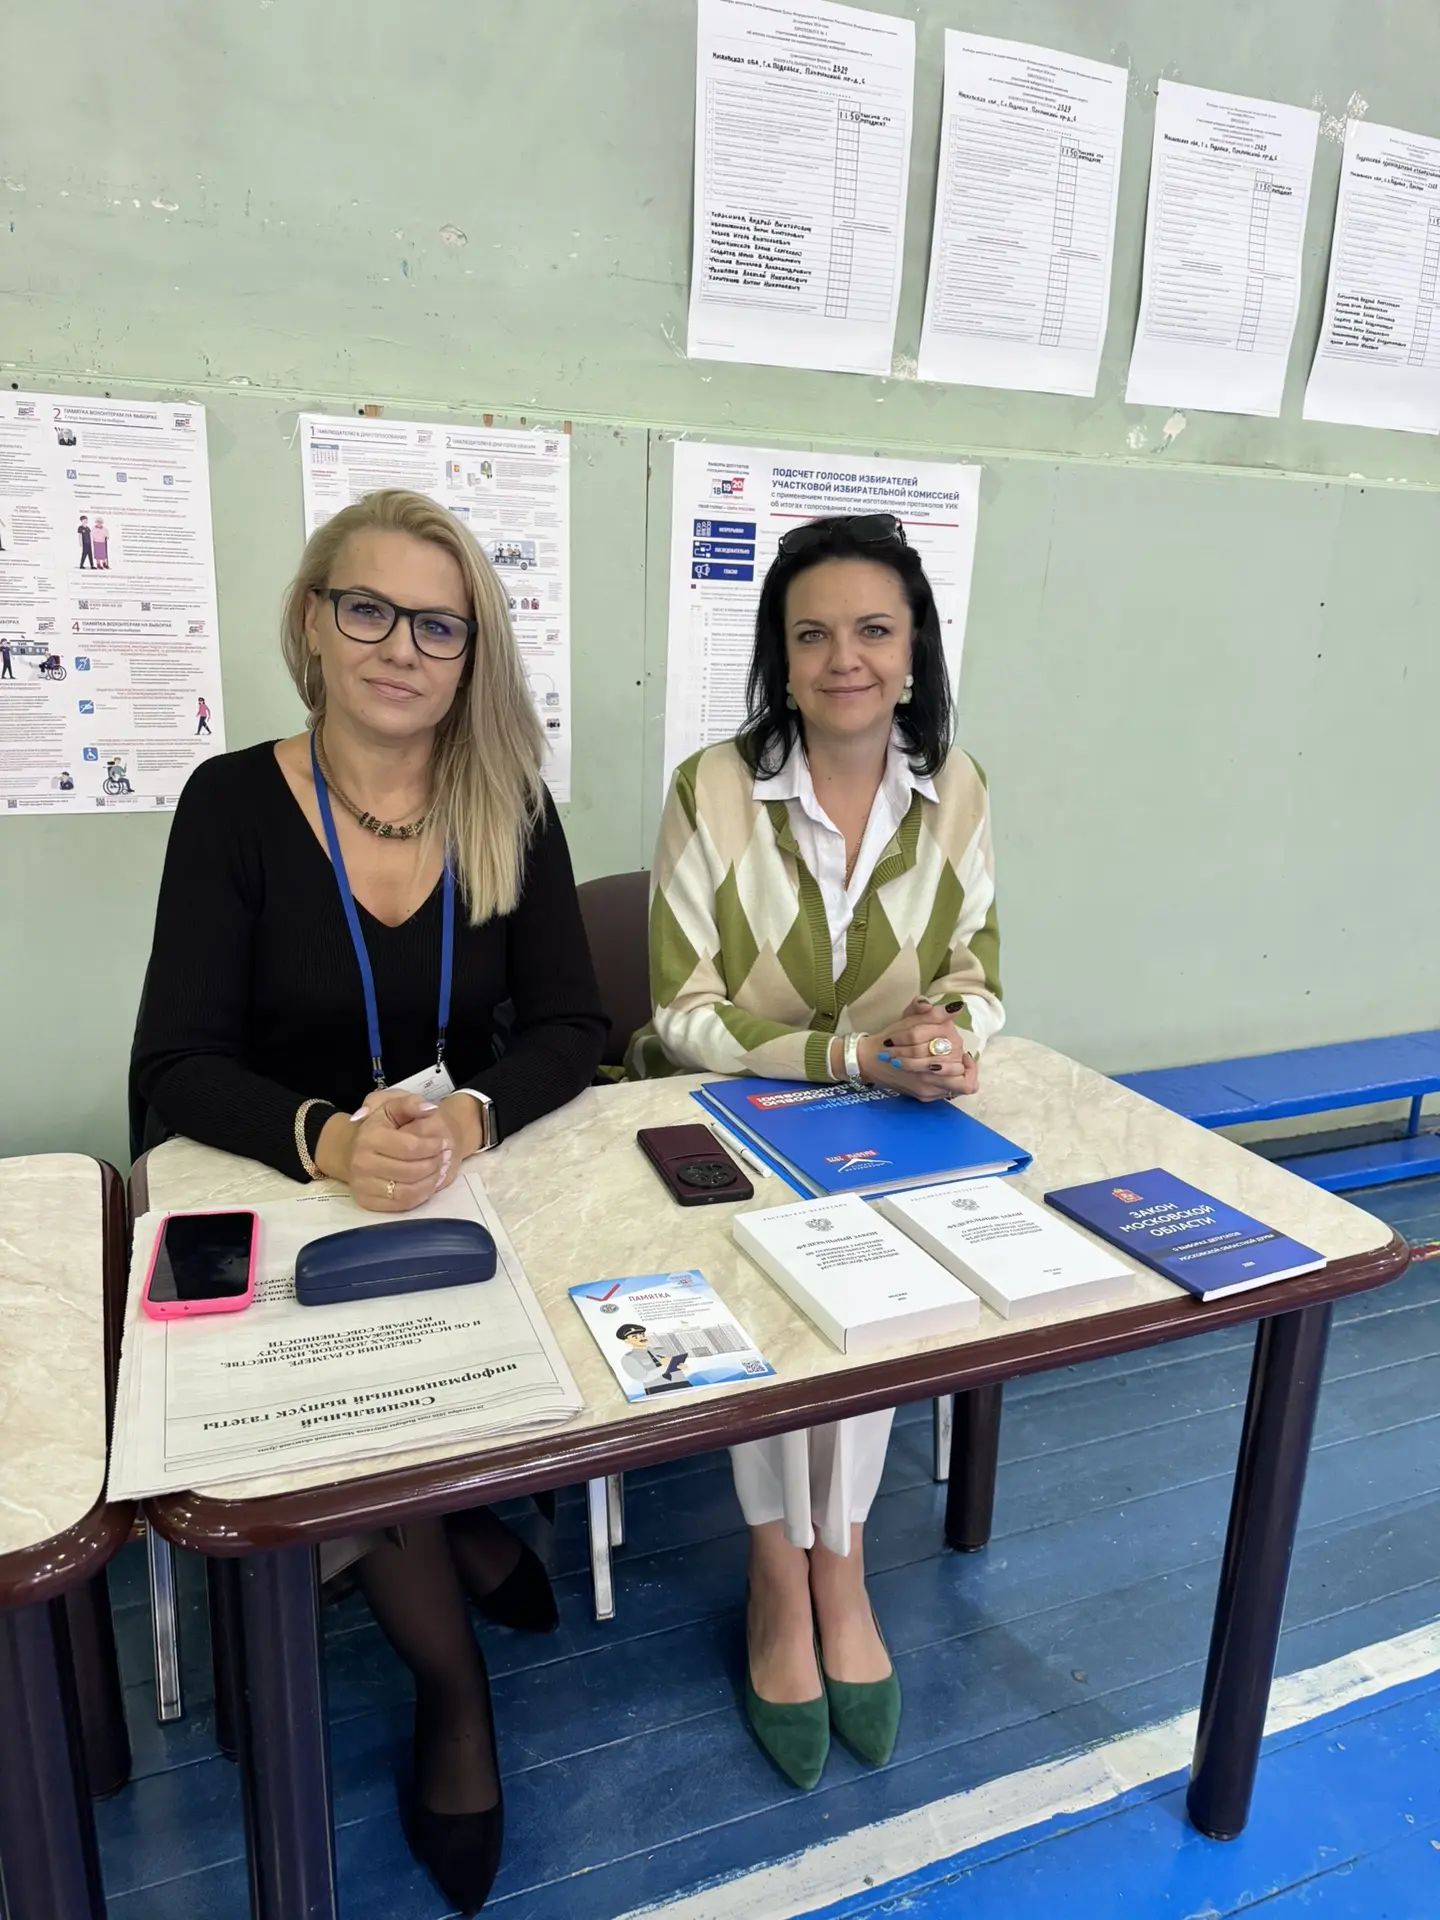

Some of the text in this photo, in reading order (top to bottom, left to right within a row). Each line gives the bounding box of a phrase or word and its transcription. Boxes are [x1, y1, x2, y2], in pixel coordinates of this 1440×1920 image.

[53, 408, 62, 420] 2
[446, 436, 452, 447] 2
[772, 468, 918, 486] ПОДСЧЕТ ГОЛОСОВ ИЗБИРАТЕЛЕЙ
[713, 480, 742, 495] 18 19 20
[772, 480, 959, 501] УЧАСТКОВОЙ ИЗБИРАТЕЛЬНОЙ КОМИССИЕЙ
[907, 501, 943, 509] протоколов
[72, 621, 80, 632] 4
[762, 1092, 836, 1107] ЛЮБОВЬЮ
[802, 1092, 889, 1112] УВАЖЕНИЕМ
[1119, 1203, 1216, 1233] МОСКОВСКОЙ
[1129, 1202, 1179, 1219] ЗАКОН
[1150, 1216, 1216, 1237] ОБЛАСТИ
[796, 1231, 878, 1250] ФЕДЕРАЛЬНЫЙ ЗАКОН
[628, 1292, 671, 1302] ПАМЯТКА
[377, 1320, 413, 1331] ПРАВЕ
[257, 1320, 446, 1357] ПРИНАДЛЕЖАЩЕМ КАНДИДАТУ
[268, 1327, 374, 1348] СОБСТВЕННОСТИ
[371, 1326, 452, 1345] ИСТОЧНИКАХ
[308, 1340, 368, 1355] ДОХОДОВ,
[358, 1337, 422, 1354] СВЕДЕНИЯ
[220, 1351, 305, 1368] ИМУЩЕСТВЕ,
[289, 1352, 342, 1367] РАЗМЕРЕ
[203, 1362, 517, 1431] информационный выпуск газеты
[300, 1395, 436, 1429] Специальный
[390, 1418, 416, 1427] Выборы
